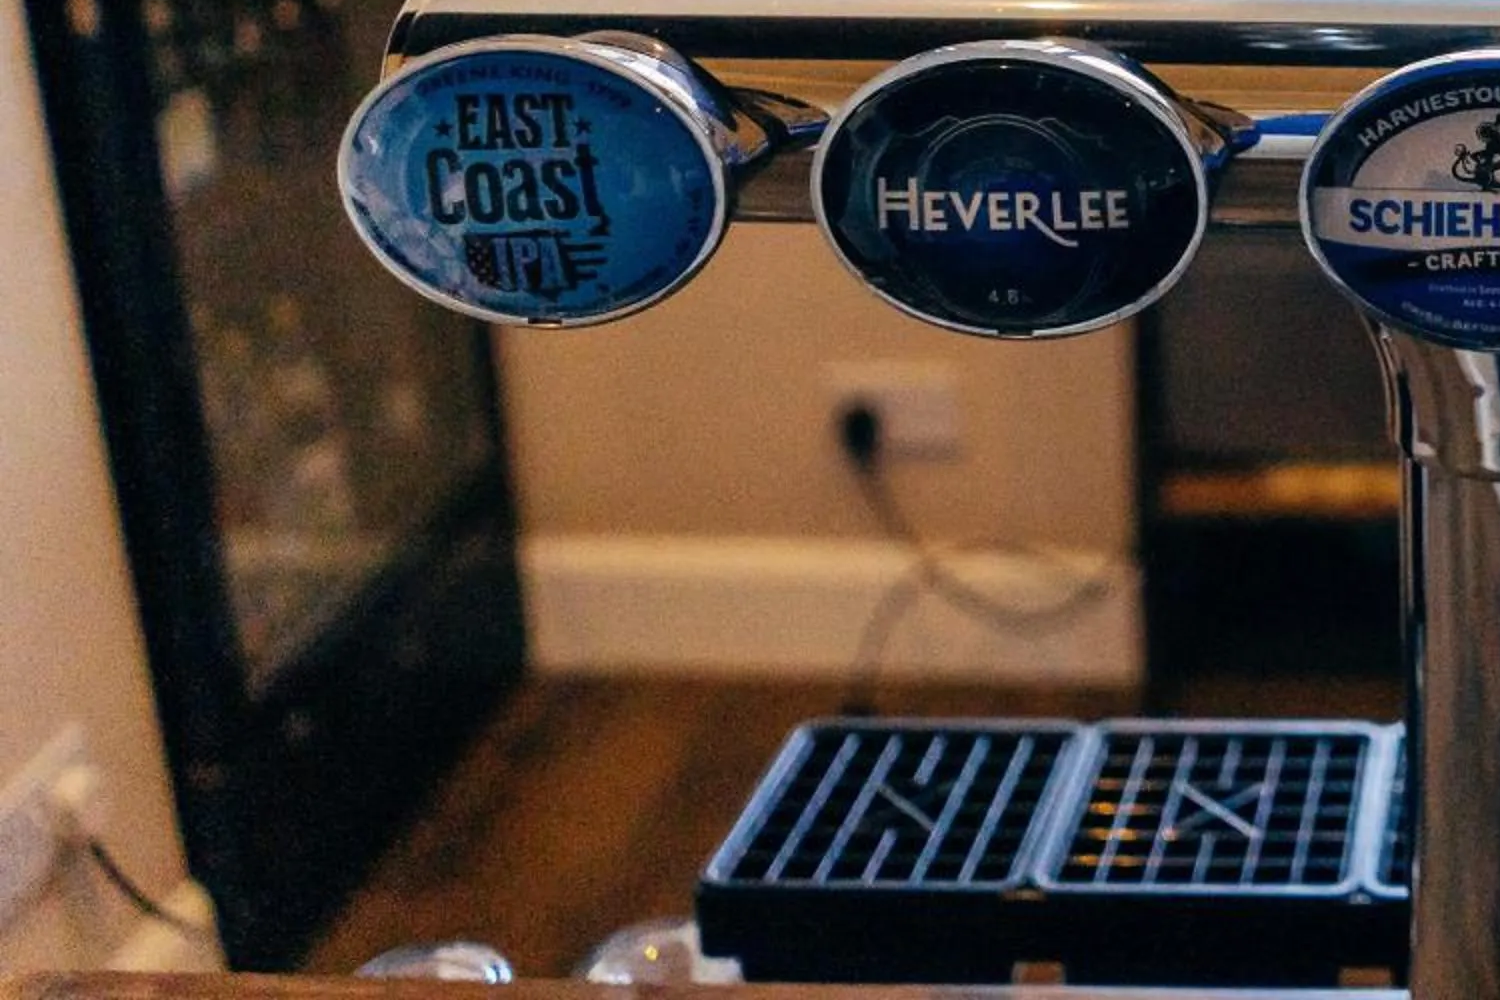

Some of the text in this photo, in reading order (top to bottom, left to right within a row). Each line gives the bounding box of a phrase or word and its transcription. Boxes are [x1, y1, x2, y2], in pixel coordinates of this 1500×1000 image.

[455, 94, 577, 150] EAST
[877, 176, 1129, 248] HEVERLEE
[490, 236, 570, 292] IPA
[1425, 250, 1500, 271] CRAFT
